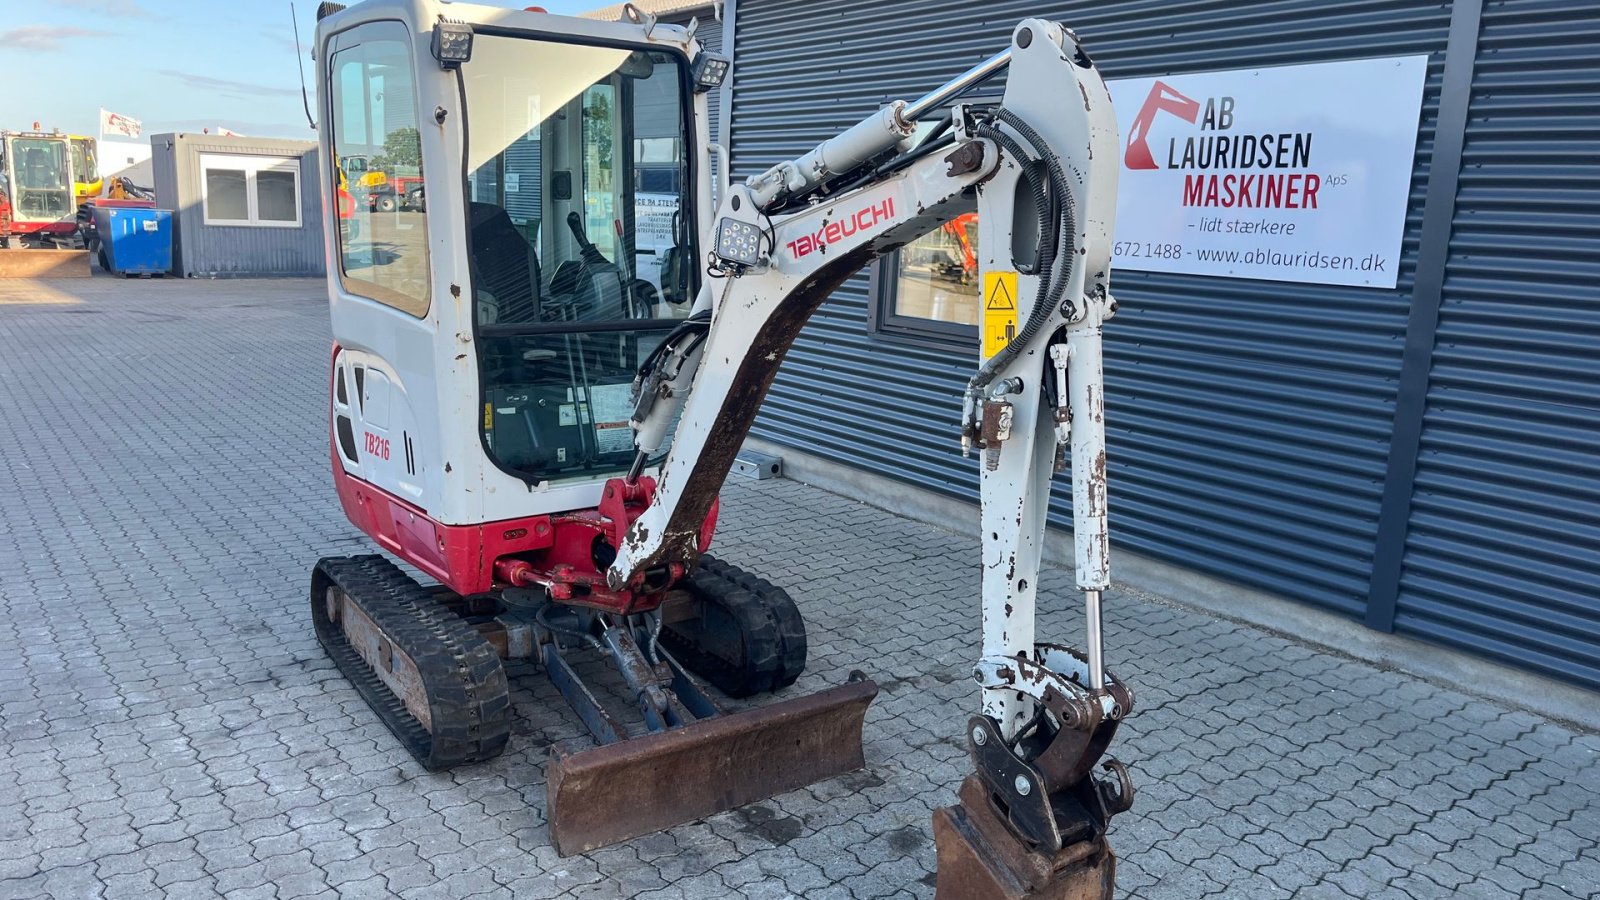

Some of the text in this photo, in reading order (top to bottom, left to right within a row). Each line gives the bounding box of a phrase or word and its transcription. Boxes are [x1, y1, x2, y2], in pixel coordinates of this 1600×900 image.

[1200, 96, 1235, 131] AB
[1167, 132, 1312, 170] LAURIDSEN
[1182, 174, 1348, 209] MASKINER ApS
[1199, 217, 1223, 233] lidt
[1225, 220, 1296, 236] stærkere
[1144, 243, 1182, 260] 1488
[1197, 247, 1386, 273] www.ablauridsen.dk
[364, 431, 390, 461] TB216
